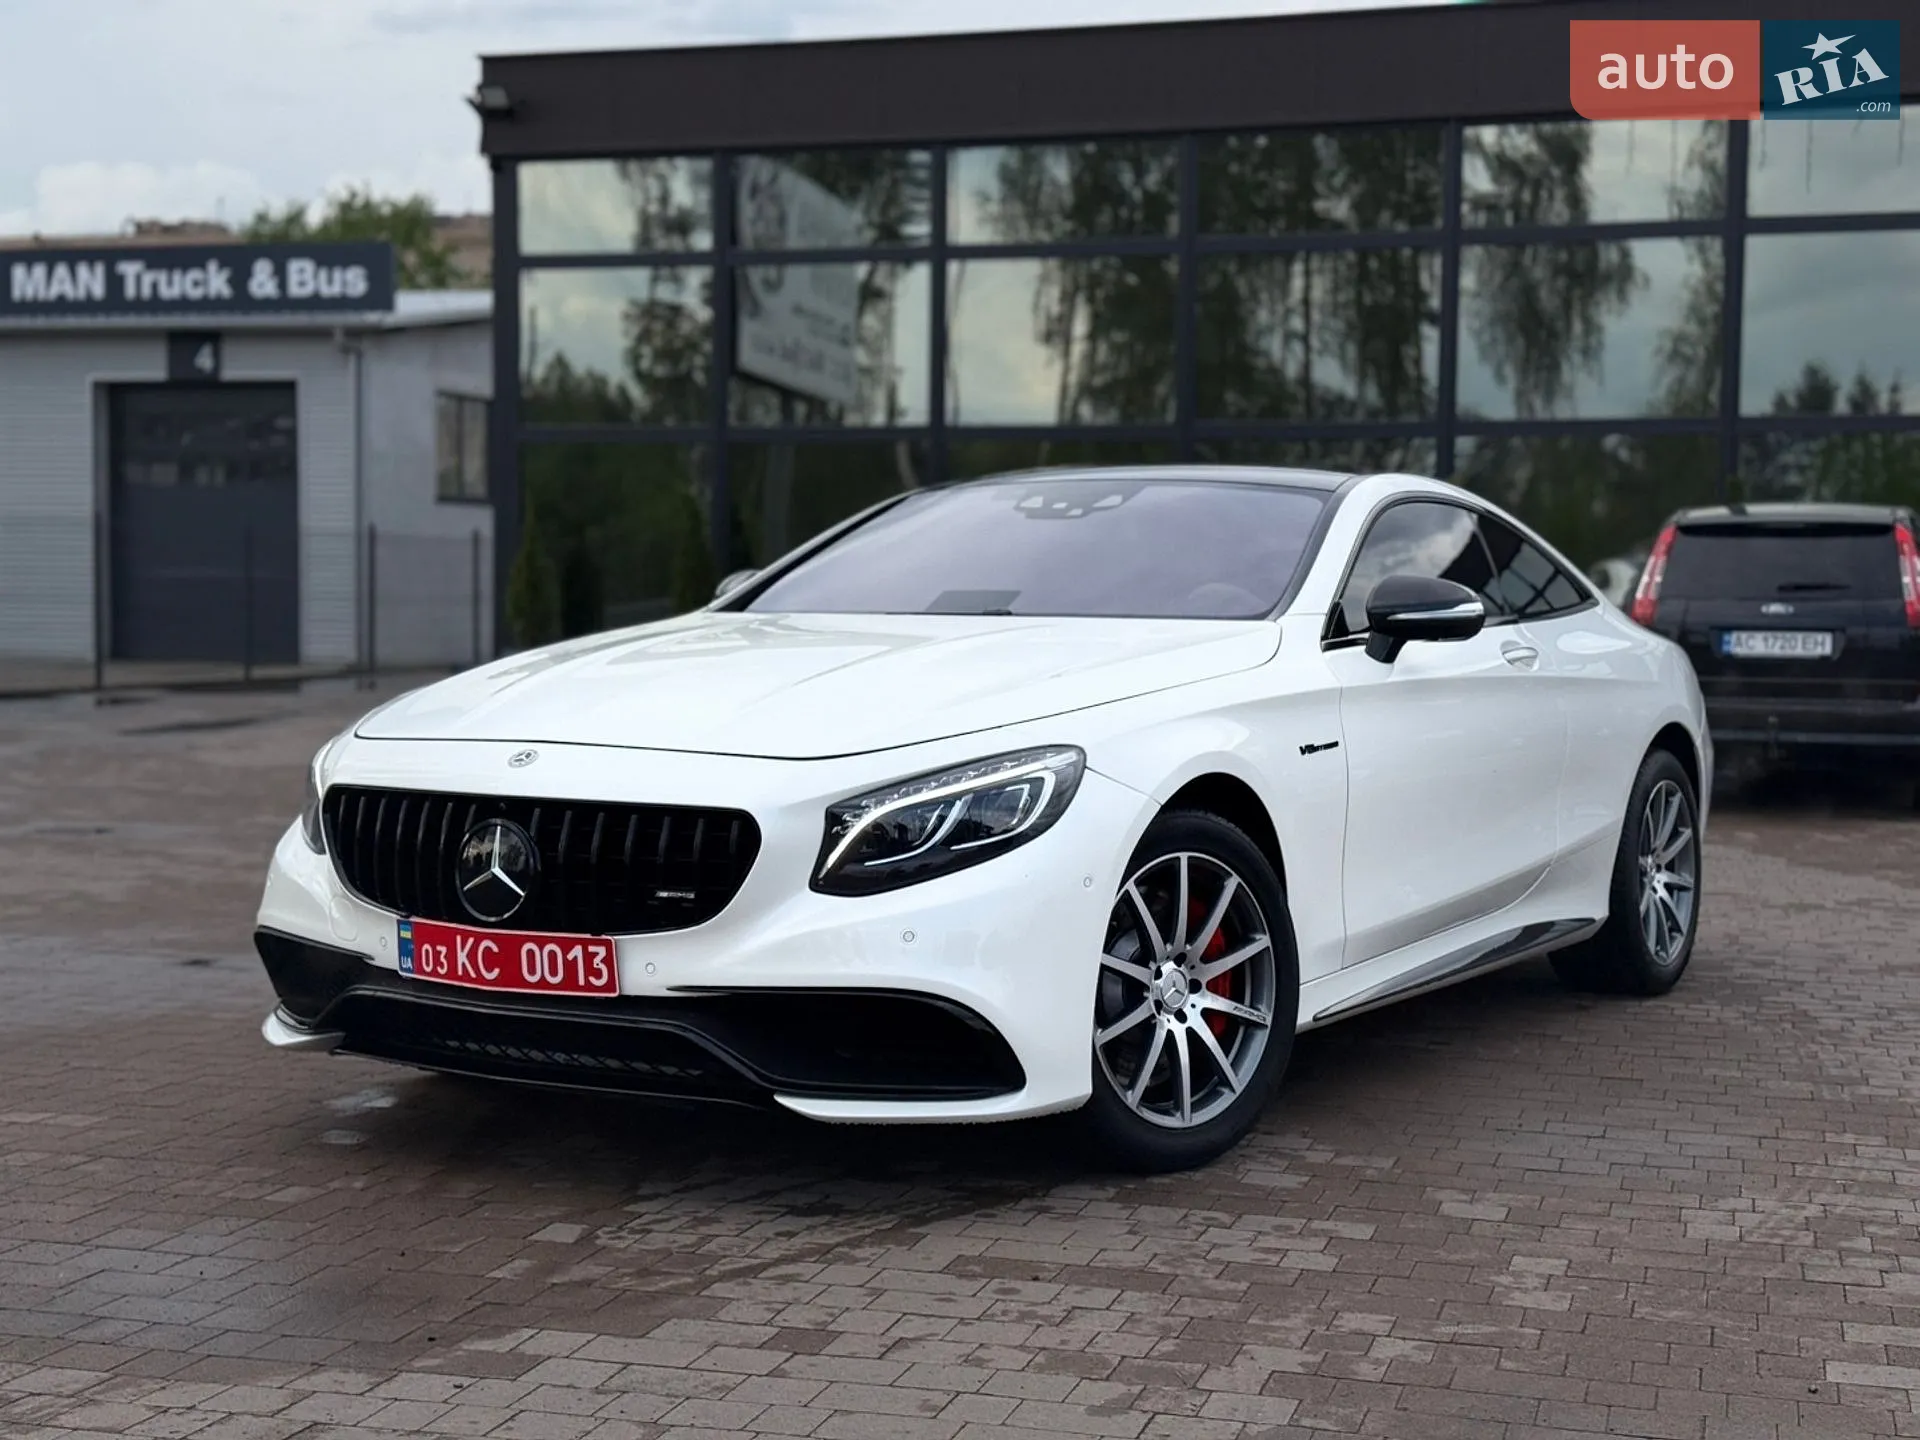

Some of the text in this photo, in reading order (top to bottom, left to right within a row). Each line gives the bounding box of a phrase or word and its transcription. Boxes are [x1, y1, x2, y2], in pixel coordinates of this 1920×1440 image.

[10, 257, 369, 300] MAN Truck & Bus
[194, 342, 215, 373] 4
[1733, 634, 1757, 650] AC
[401, 956, 413, 970] UA
[421, 935, 608, 986] 03 KC 0013
